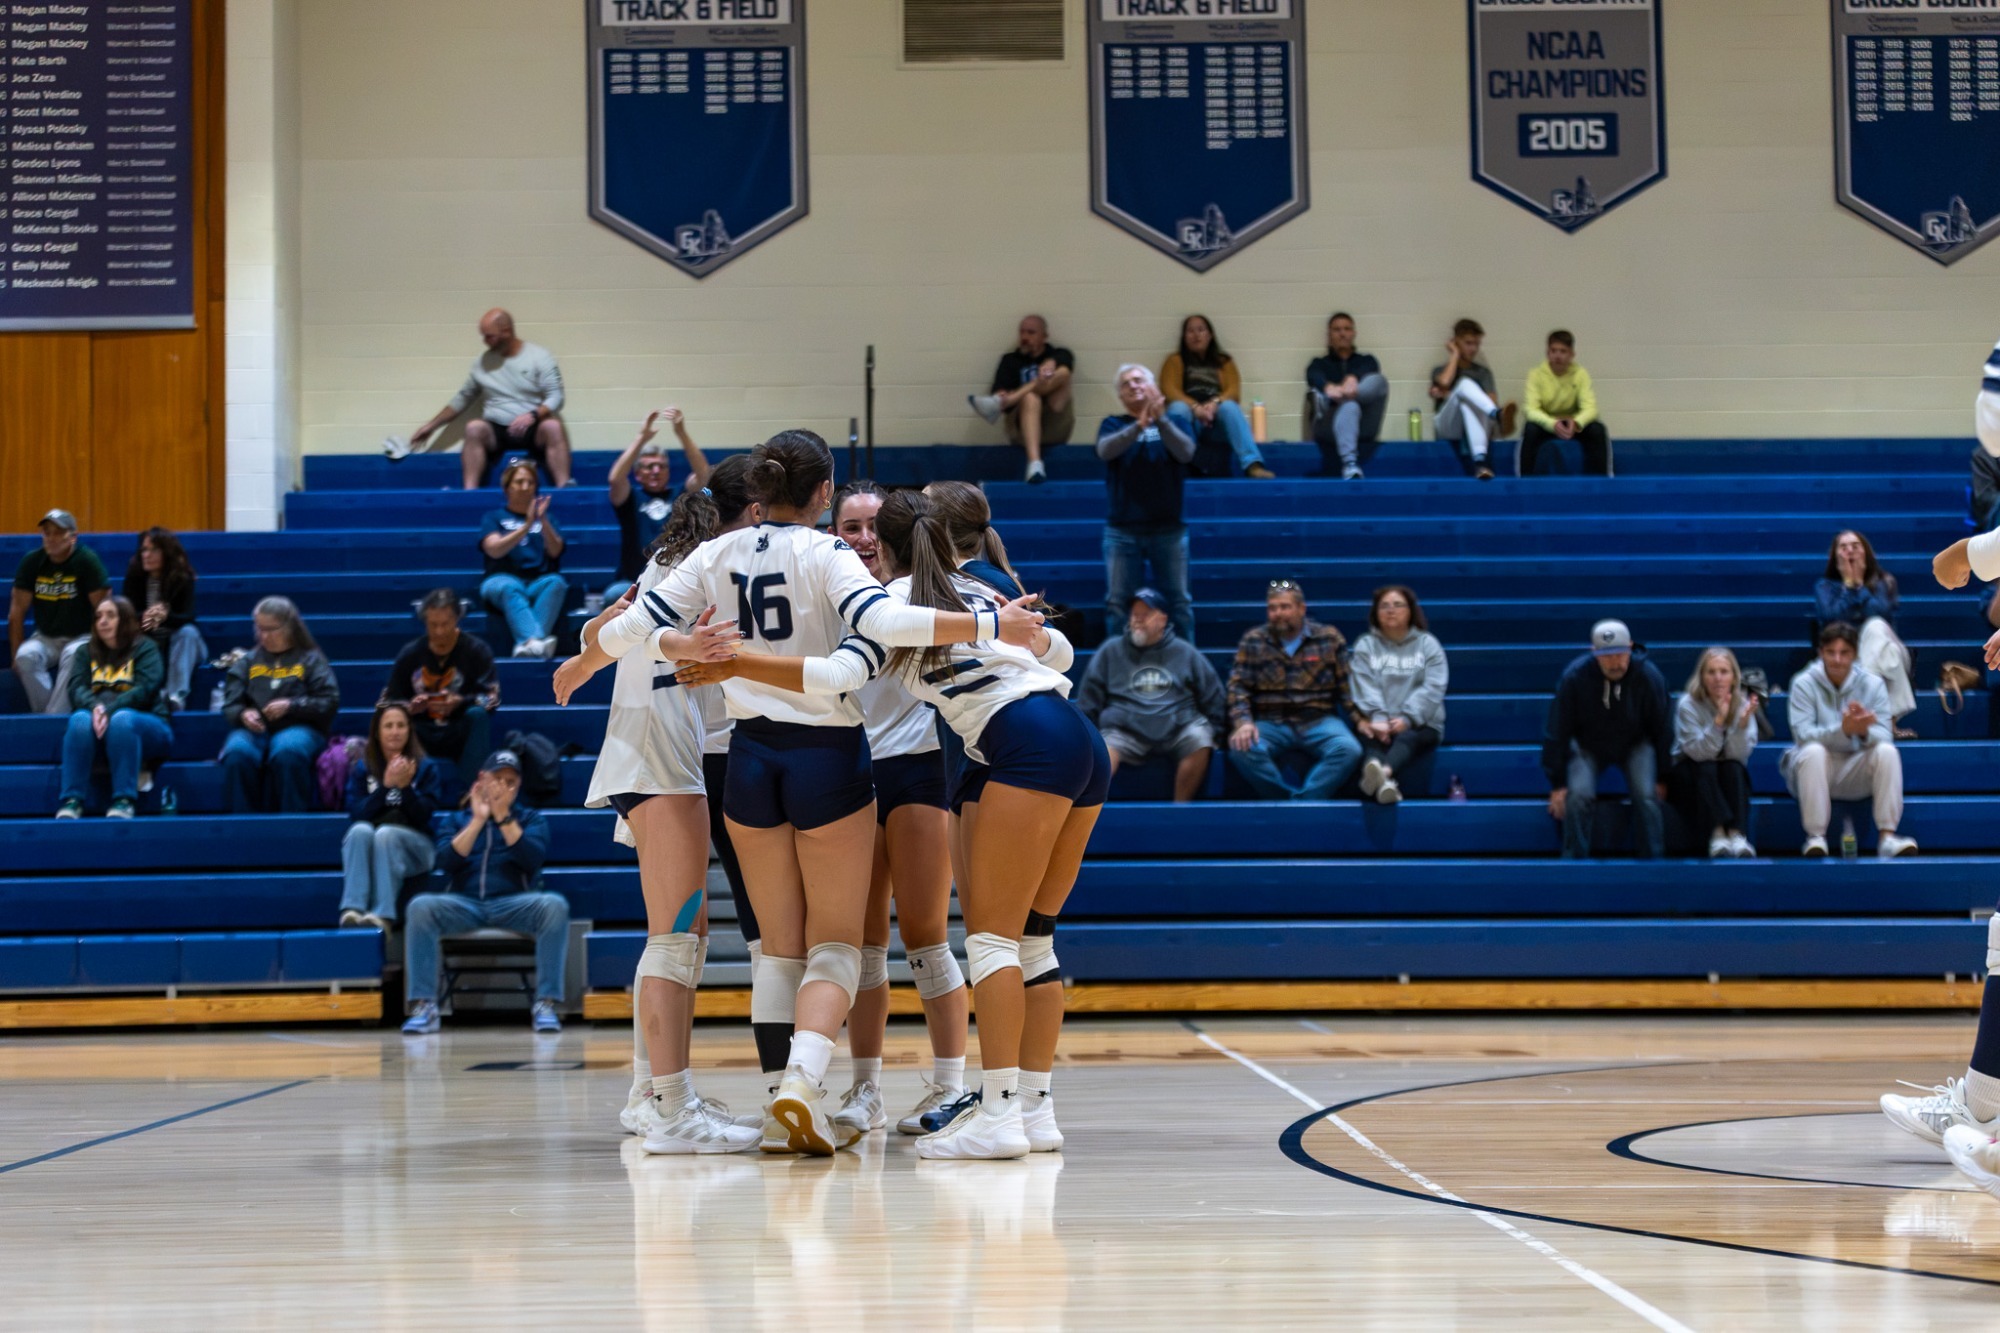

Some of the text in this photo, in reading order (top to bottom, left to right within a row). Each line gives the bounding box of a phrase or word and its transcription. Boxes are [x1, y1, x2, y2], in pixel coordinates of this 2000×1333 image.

[11, 4, 46, 16] Megan
[48, 4, 88, 16] Mackey
[612, 0, 689, 20] TRACK
[718, 0, 778, 19] FIELD
[1115, 0, 1190, 16] TRACK
[1217, 0, 1278, 15] FIELD
[11, 21, 46, 33] Megan
[48, 21, 88, 33] Mackey
[11, 38, 46, 50] Megan
[48, 38, 88, 50] Mackey
[1527, 31, 1605, 60] NCAA
[11, 56, 36, 65] Kate
[38, 56, 66, 65] Barth
[11, 73, 29, 82] Joe
[1488, 68, 1647, 99] CHAMPIONS
[11, 107, 39, 116] Scott
[41, 107, 79, 116] Morton
[1529, 119, 1607, 151] 2005
[11, 140, 51, 150] Melissa
[53, 140, 94, 150] Graham
[11, 158, 49, 169] Gordon
[50, 158, 81, 169] Lyons
[11, 208, 43, 219] Grace
[10, 241, 42, 253] Grace
[11, 260, 39, 271] Emily
[730, 572, 793, 642] 16
